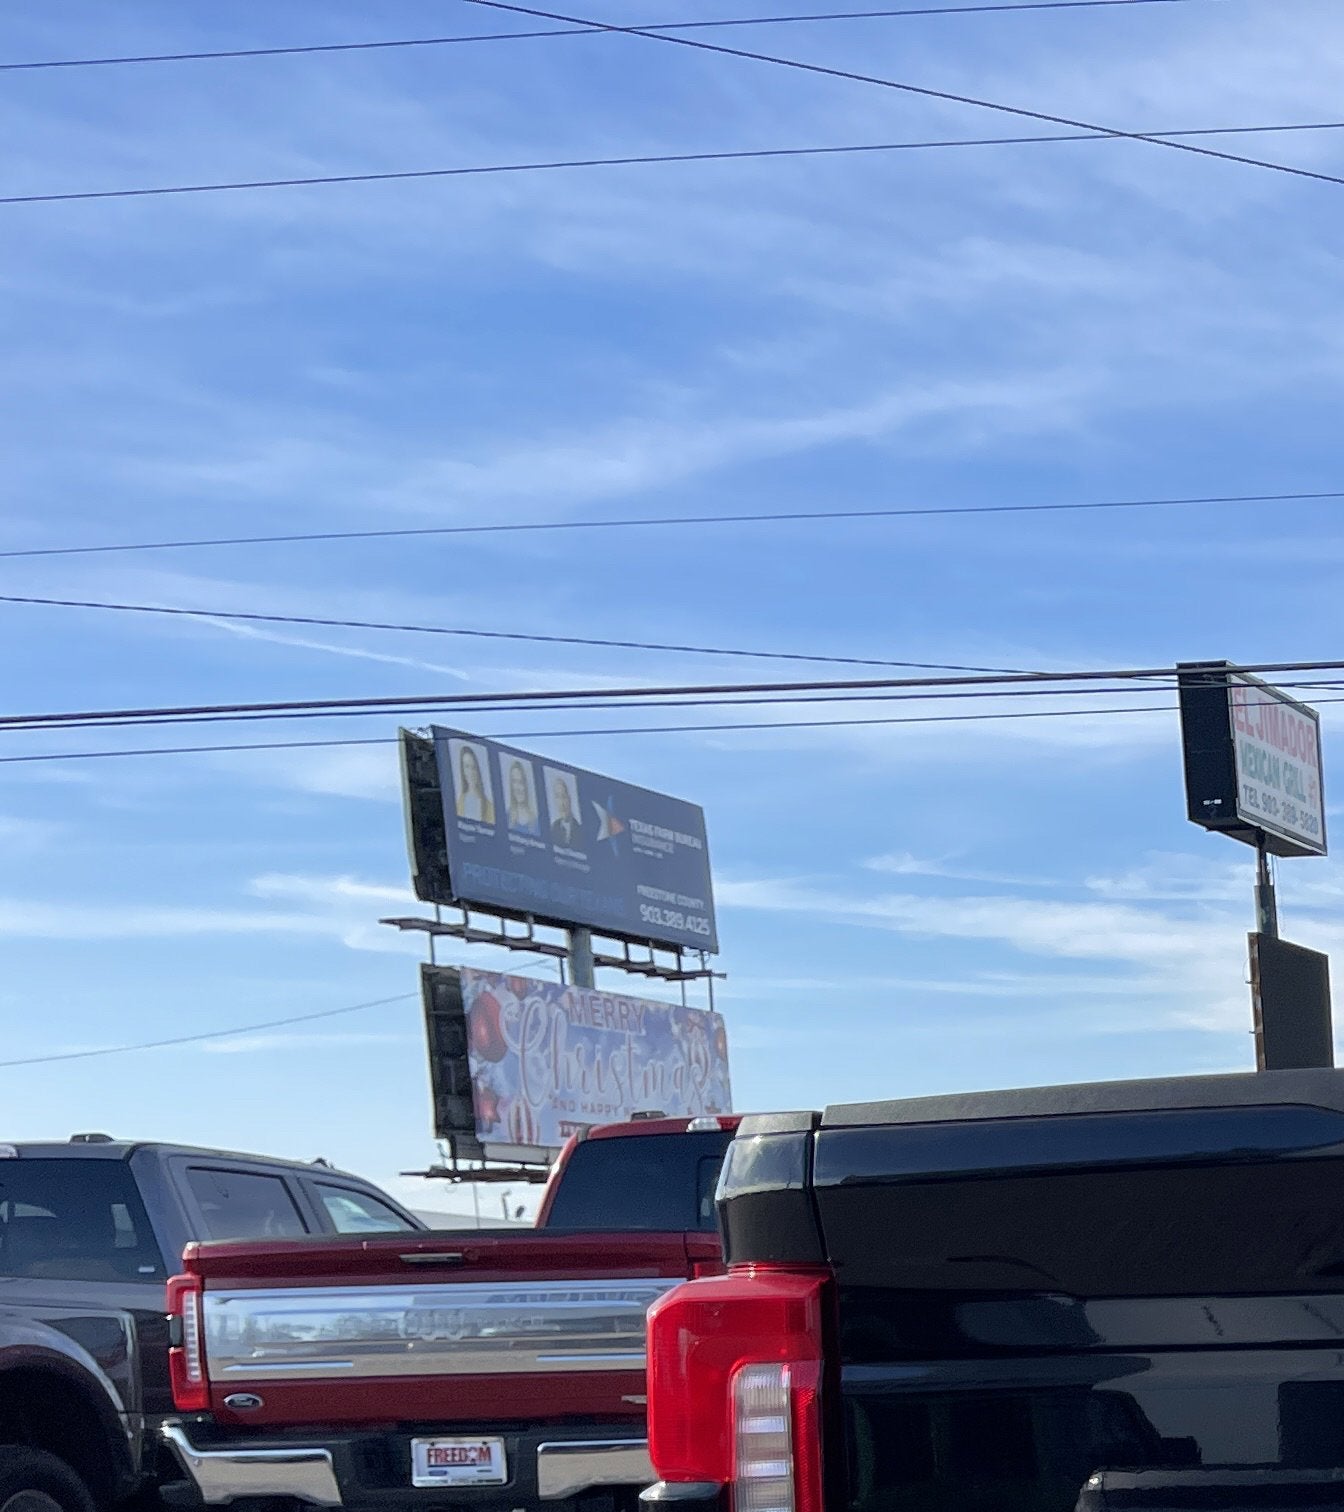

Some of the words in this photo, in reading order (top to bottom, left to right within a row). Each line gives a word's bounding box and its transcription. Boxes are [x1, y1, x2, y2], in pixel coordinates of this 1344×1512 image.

[1234, 687, 1254, 737] EL
[1255, 699, 1317, 768] JIMADOR
[566, 991, 646, 1034] MERRY
[501, 996, 708, 1107] Christmas
[581, 1103, 618, 1117] HAPPY
[427, 1446, 492, 1466] FREEDOM
